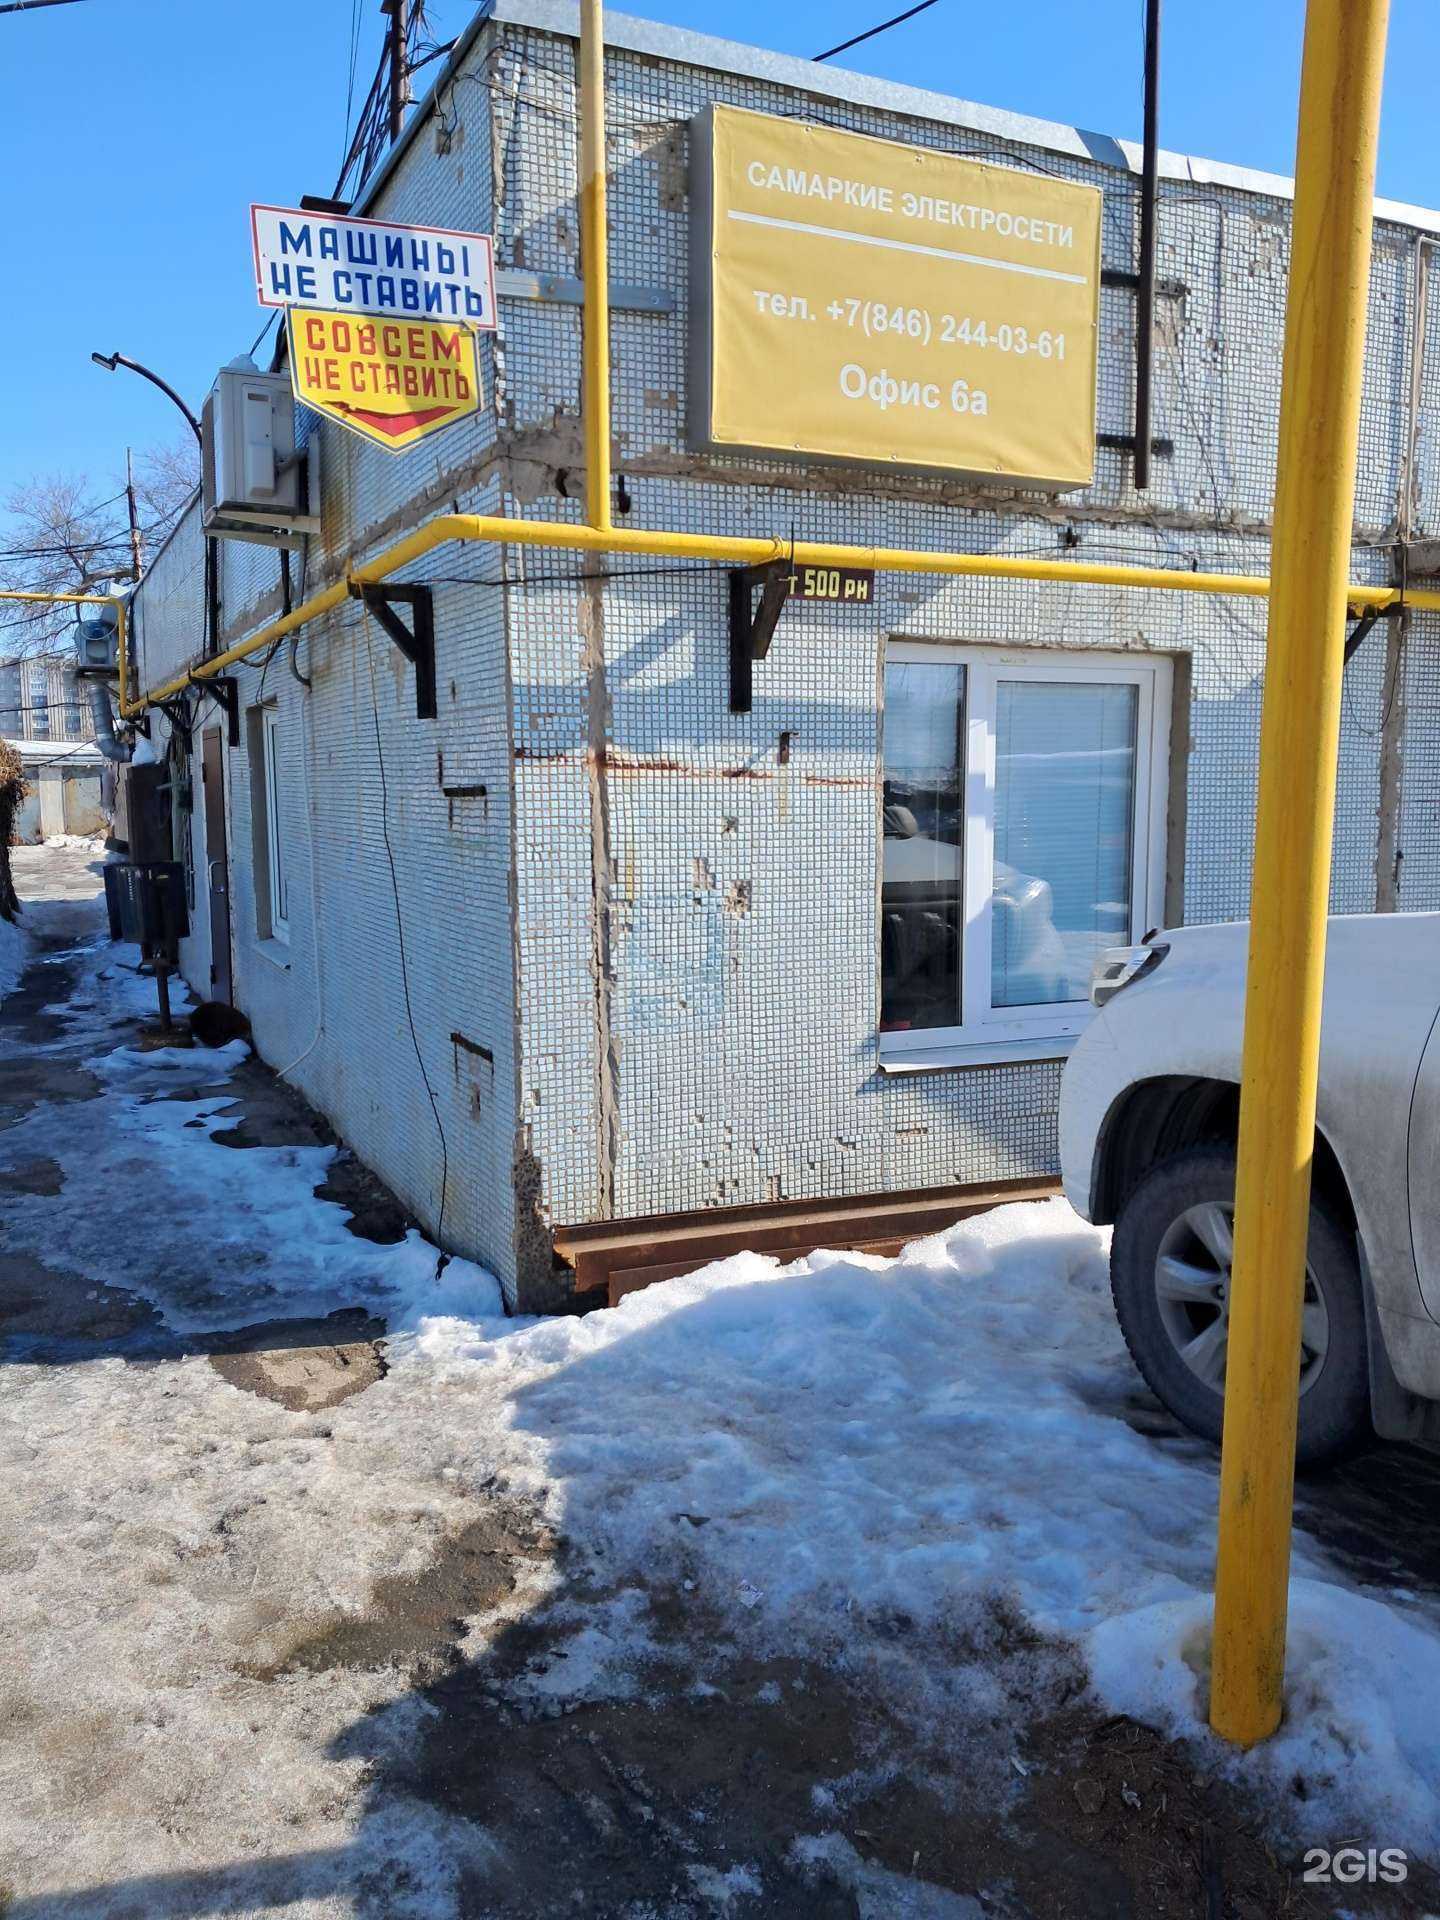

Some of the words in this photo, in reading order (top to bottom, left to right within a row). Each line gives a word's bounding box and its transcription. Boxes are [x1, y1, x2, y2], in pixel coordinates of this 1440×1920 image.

[748, 161, 893, 213] САМАРКИЕ
[902, 193, 1073, 248] ЭЛЕКТРОСЕТИ
[279, 221, 470, 277] МАШИНЫ
[270, 261, 318, 299] НЕ
[333, 270, 483, 317] СТАВИТЬ
[305, 318, 461, 362] СОВСЕМ
[753, 290, 816, 321] тел.
[827, 297, 932, 346] +7(846)
[941, 314, 1065, 360] 244-03-61
[304, 356, 341, 390] НЕ
[349, 361, 470, 399] СТАВИТЬ
[839, 363, 940, 409] Офис
[951, 380, 988, 415] 6а
[804, 569, 840, 598] 500
